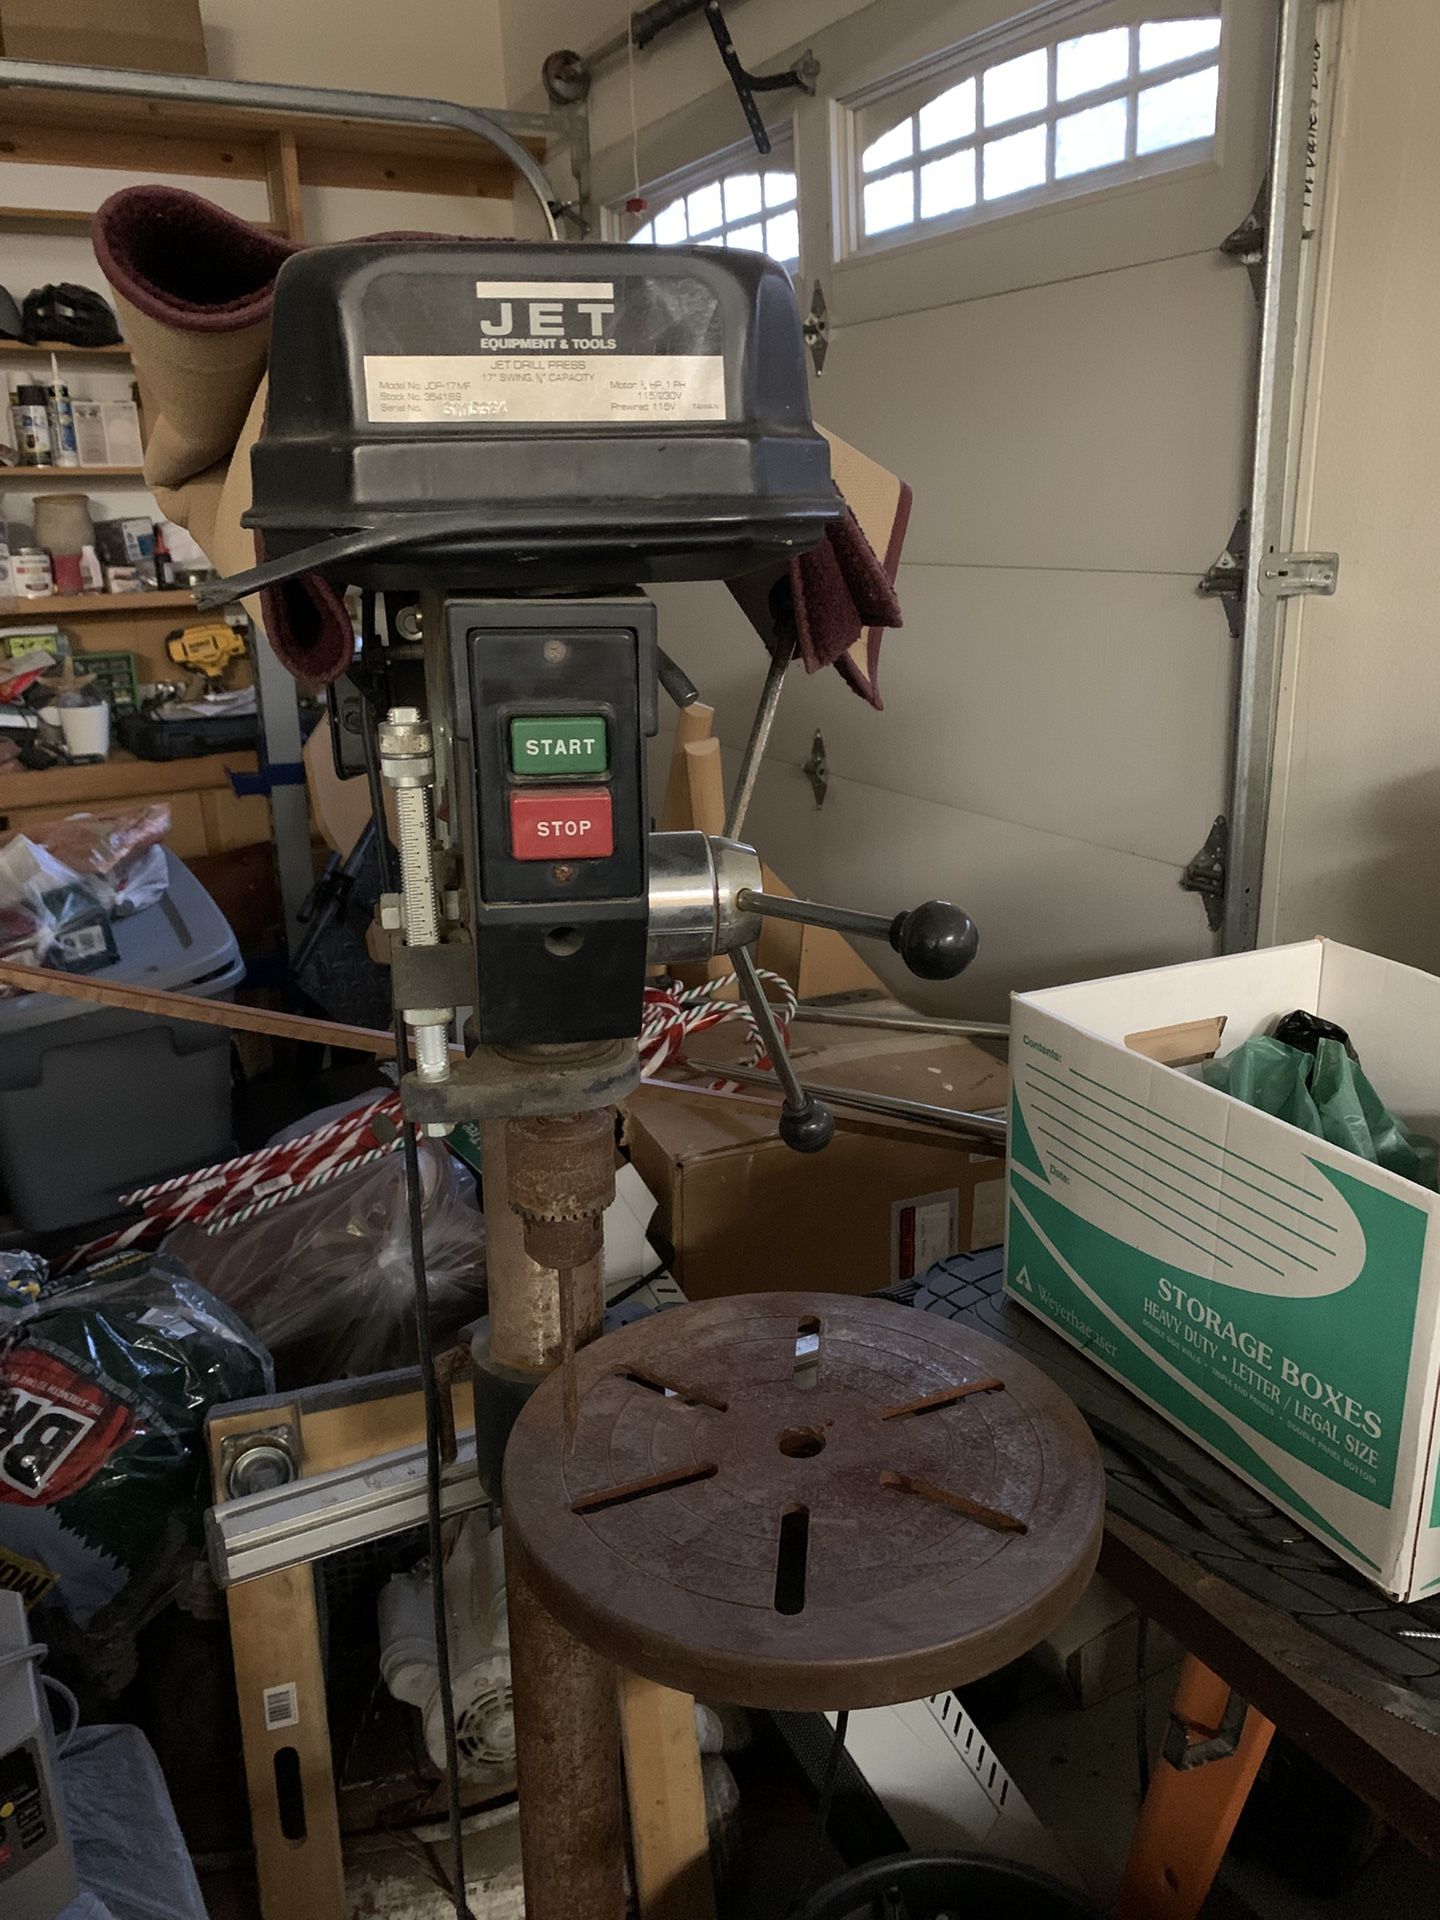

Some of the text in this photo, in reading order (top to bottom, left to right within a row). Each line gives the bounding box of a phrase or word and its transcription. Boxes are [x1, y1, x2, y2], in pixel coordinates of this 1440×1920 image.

[480, 302, 615, 336] JET
[480, 338, 617, 350] EQUIPMENT & TOOLS
[490, 360, 587, 370] JET DRILL PRESS
[549, 373, 596, 382] CAPACITY
[379, 381, 405, 390] Model
[380, 392, 405, 401] Stock
[380, 403, 405, 412] Serial
[652, 402, 676, 411] 115V
[526, 739, 595, 755] START
[537, 821, 591, 836] STOP
[1023, 1034, 1062, 1063] Contents:
[1050, 1164, 1070, 1185] Date:
[1158, 1277, 1382, 1438] STORAGE BOXES
[1143, 1297, 1182, 1334] HEAVY
[1184, 1324, 1218, 1358] DUTY
[1231, 1357, 1282, 1405] LETTER
[1294, 1400, 1341, 1445] LEGAL
[1344, 1433, 1379, 1469] SIZE
